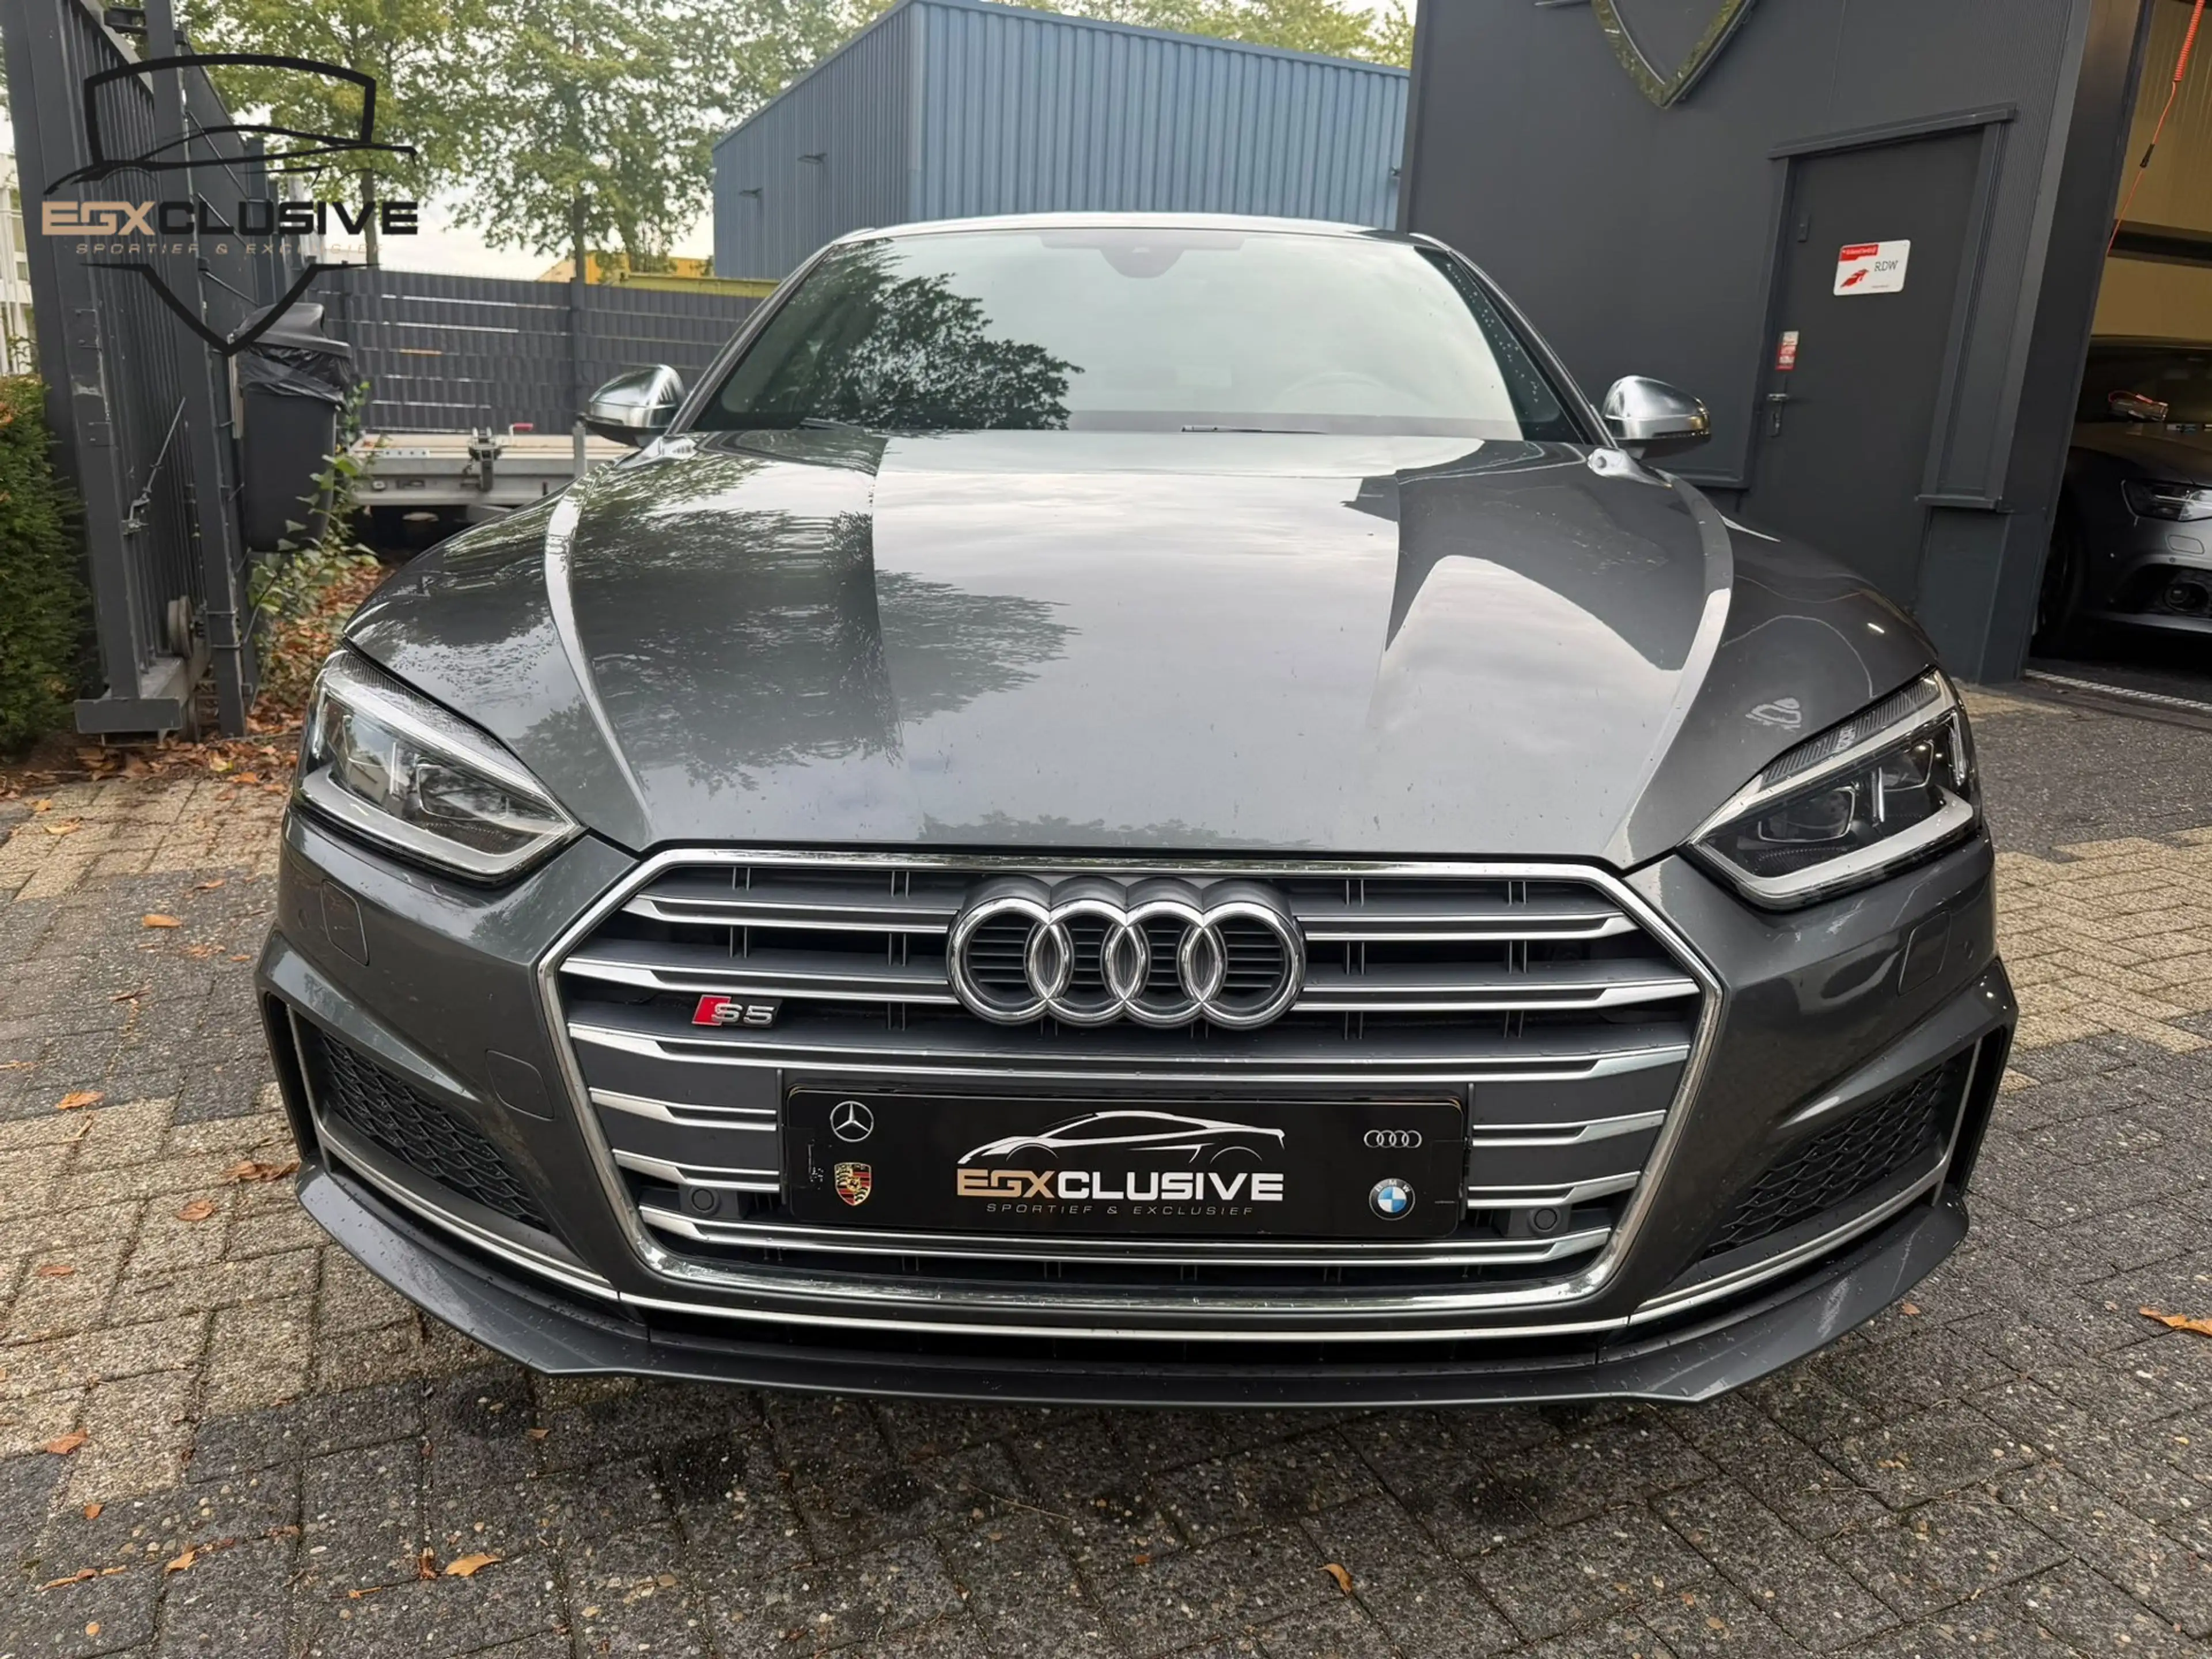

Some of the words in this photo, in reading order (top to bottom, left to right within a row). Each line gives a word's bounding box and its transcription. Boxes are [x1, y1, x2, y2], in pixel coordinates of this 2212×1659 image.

[1874, 260, 1899, 272] RDW
[711, 1002, 775, 1025] S5
[957, 1168, 1284, 1202] EGXCLUSIVE
[1374, 1179, 1411, 1192] BMW
[986, 1203, 1094, 1214] SPORTIEF
[1107, 1206, 1118, 1215] &
[1133, 1206, 1255, 1215] EXCLUSIEF
